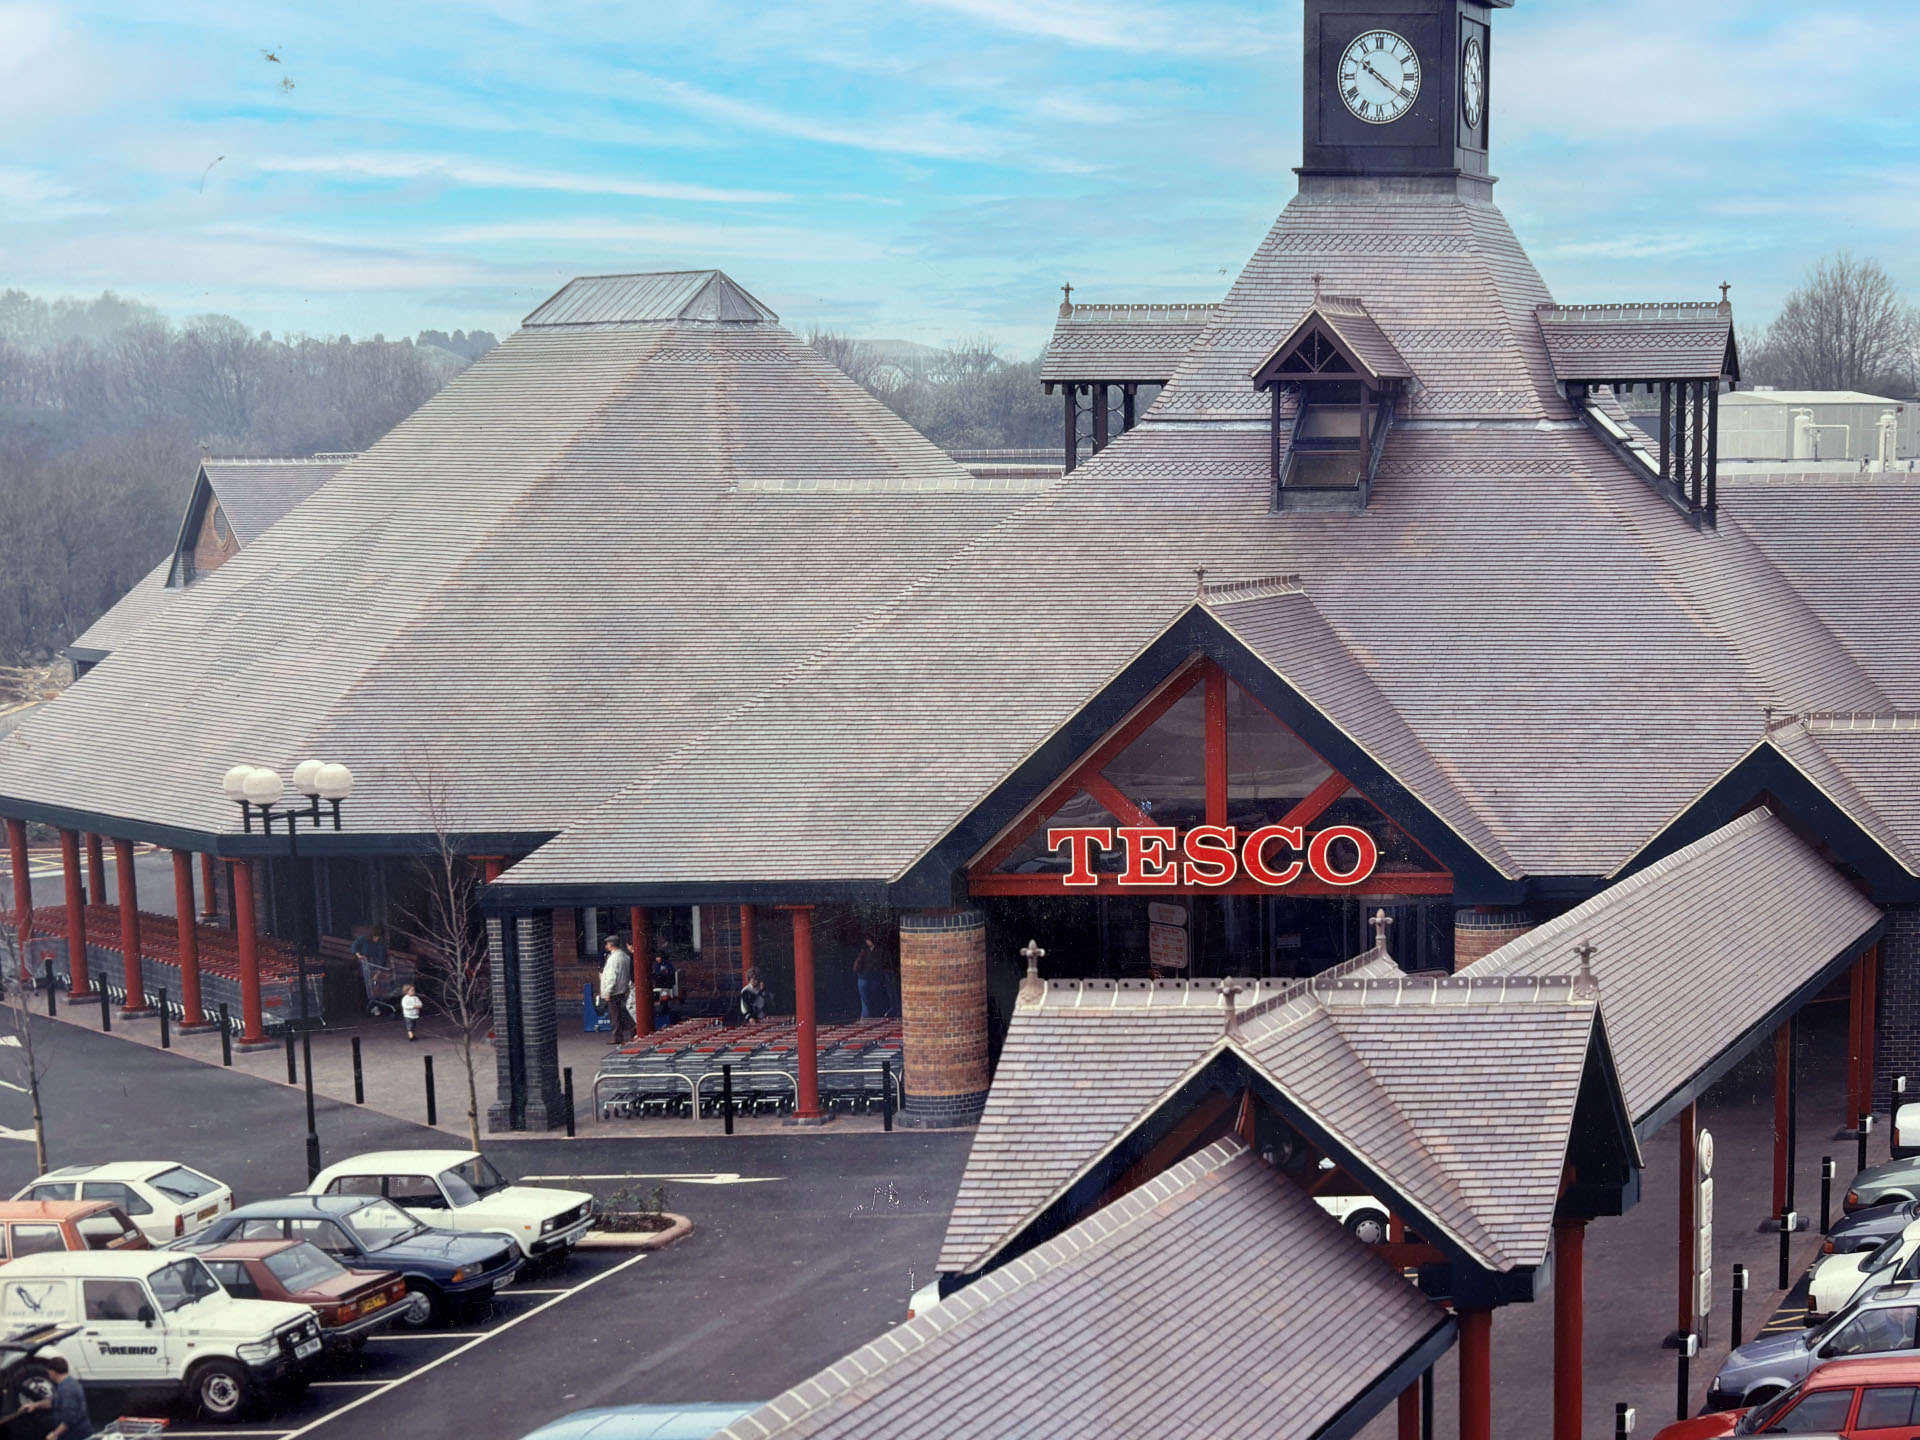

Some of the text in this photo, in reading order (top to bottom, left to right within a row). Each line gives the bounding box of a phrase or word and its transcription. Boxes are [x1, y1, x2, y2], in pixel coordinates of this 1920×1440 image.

[1359, 41, 1369, 53] XI
[1375, 37, 1384, 49] XII
[1348, 55, 1360, 65] X
[1399, 55, 1411, 64] II
[1403, 73, 1415, 81] III
[1359, 99, 1370, 114] VII
[1375, 104, 1384, 117] VI
[1391, 100, 1399, 112] V
[1047, 824, 1378, 887] TESCO
[97, 1342, 158, 1356] FIREBIRD
